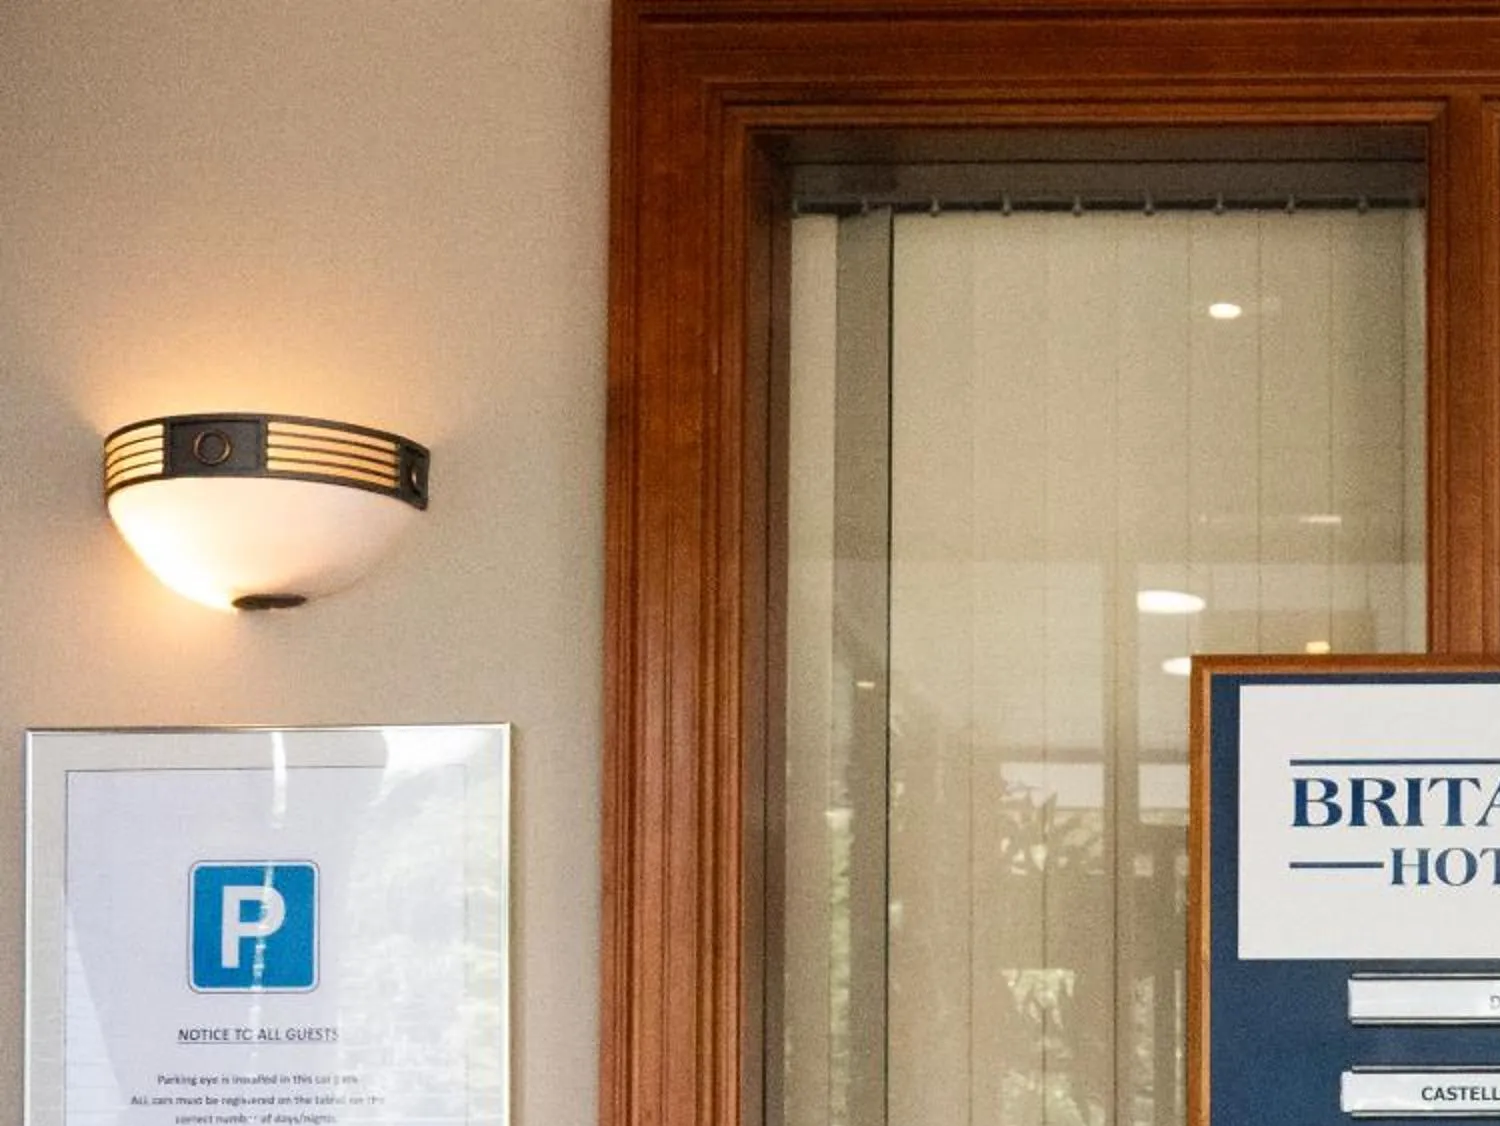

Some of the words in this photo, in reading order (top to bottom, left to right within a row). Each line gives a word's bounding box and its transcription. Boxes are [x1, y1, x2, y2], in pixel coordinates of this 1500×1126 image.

[177, 1028, 229, 1042] NOTICE
[257, 1028, 282, 1042] ALL
[285, 1028, 340, 1042] GUESTS
[158, 1074, 198, 1087] Parking
[200, 1076, 218, 1087] eye
[293, 1074, 313, 1085] this
[206, 1095, 218, 1105] be
[294, 1095, 313, 1105] the
